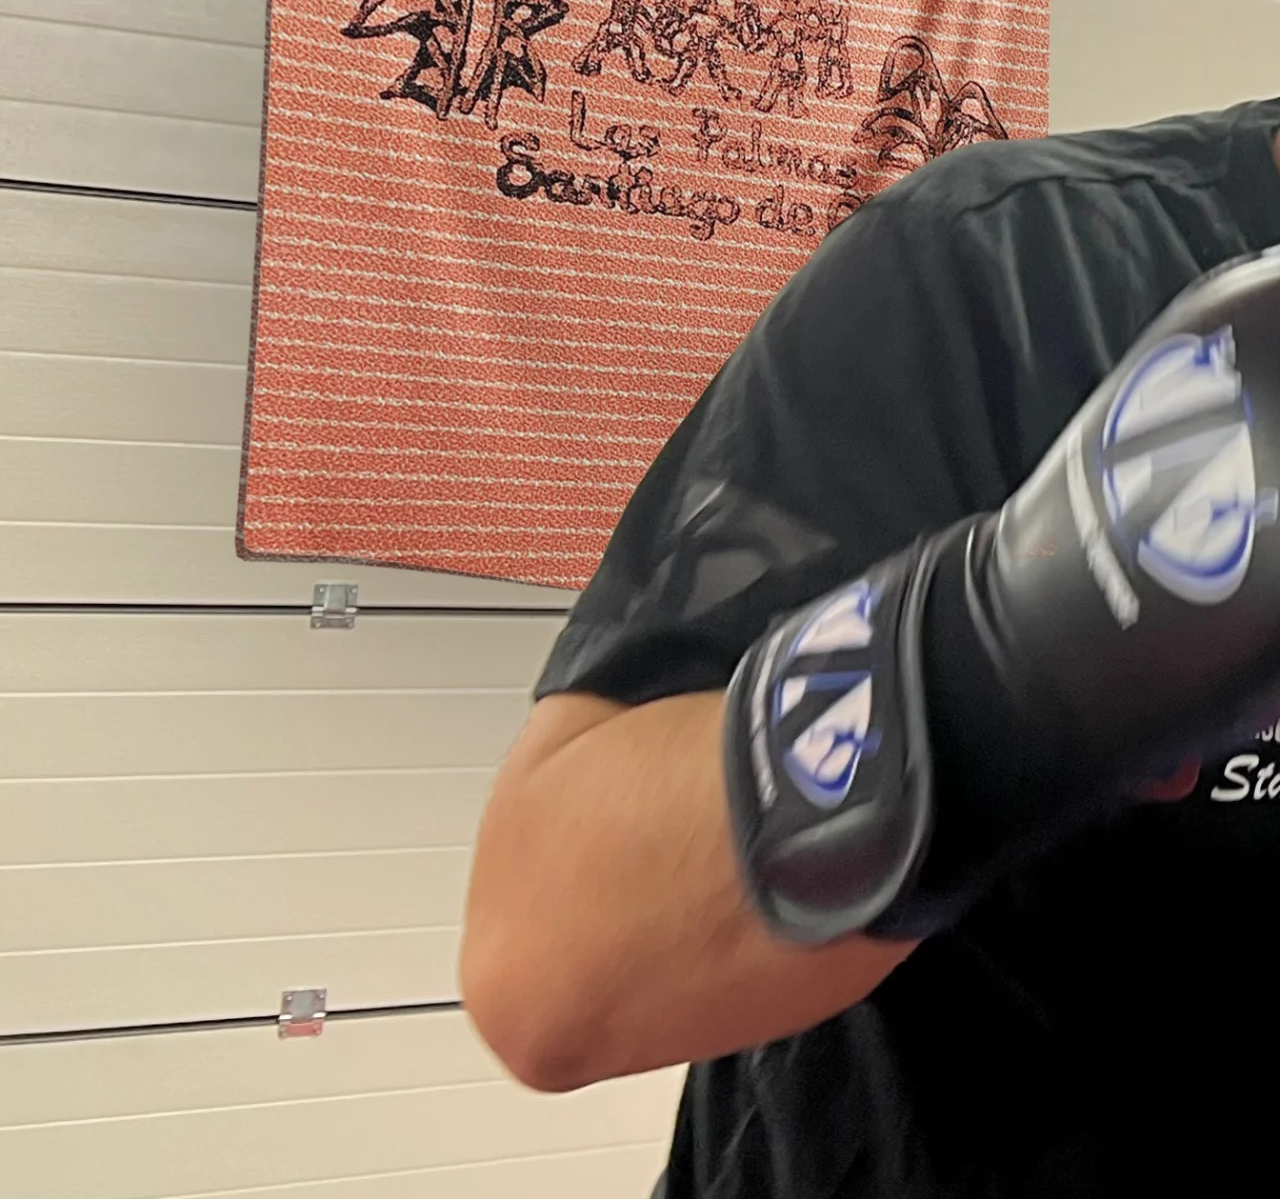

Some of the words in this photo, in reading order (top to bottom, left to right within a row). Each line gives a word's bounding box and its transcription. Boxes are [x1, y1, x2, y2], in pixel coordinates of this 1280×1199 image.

[496, 132, 741, 241] Santiago
[755, 184, 816, 238] de
[570, 90, 662, 161] Las
[693, 105, 858, 189] Palmas
